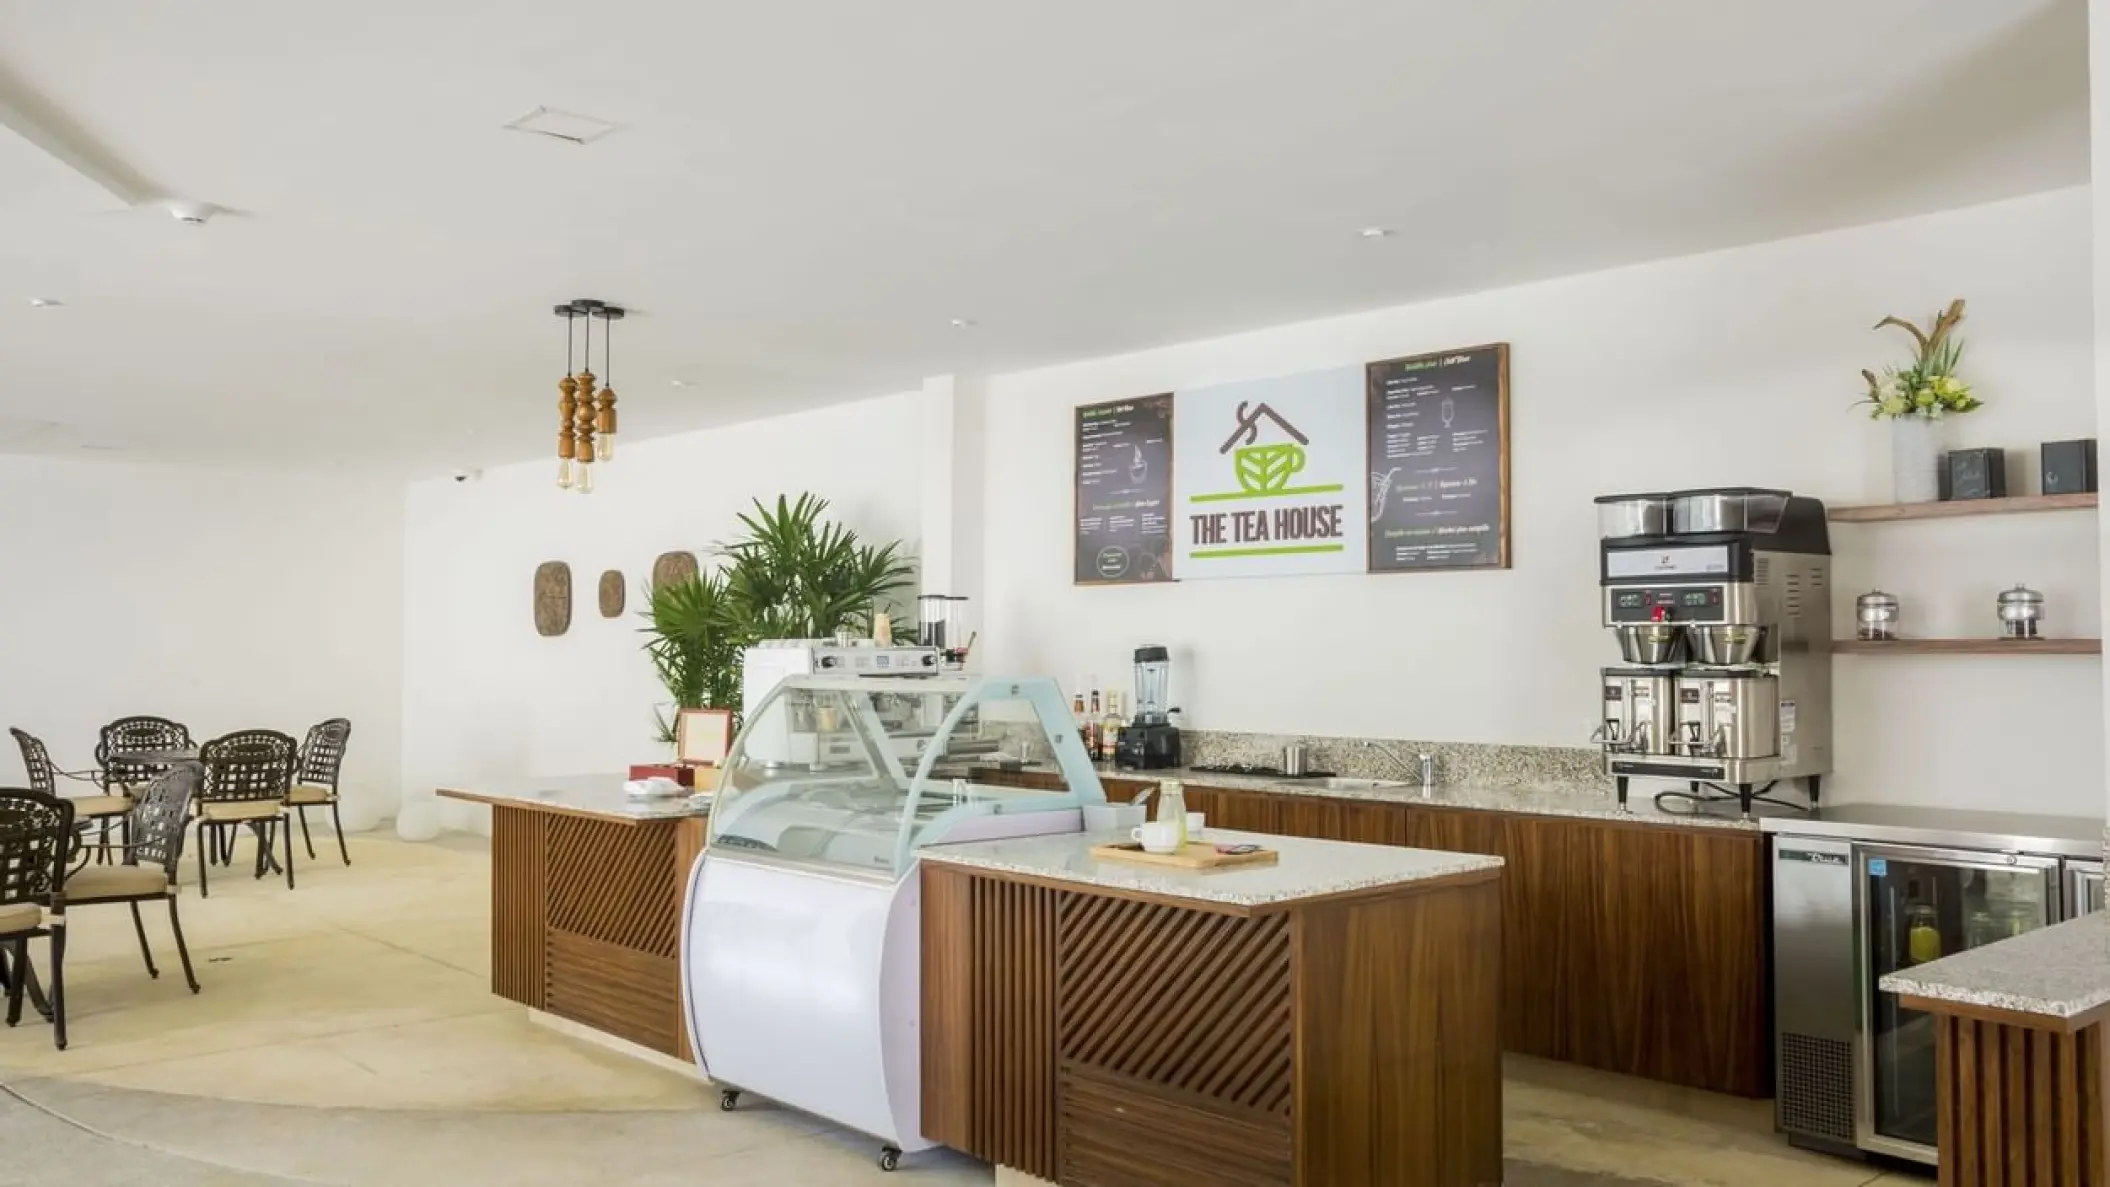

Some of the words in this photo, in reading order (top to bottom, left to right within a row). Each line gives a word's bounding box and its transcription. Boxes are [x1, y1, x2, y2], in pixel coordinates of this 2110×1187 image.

[1189, 513, 1227, 545] THE
[1231, 510, 1270, 542] TEA
[1274, 504, 1344, 540] HOUSE
